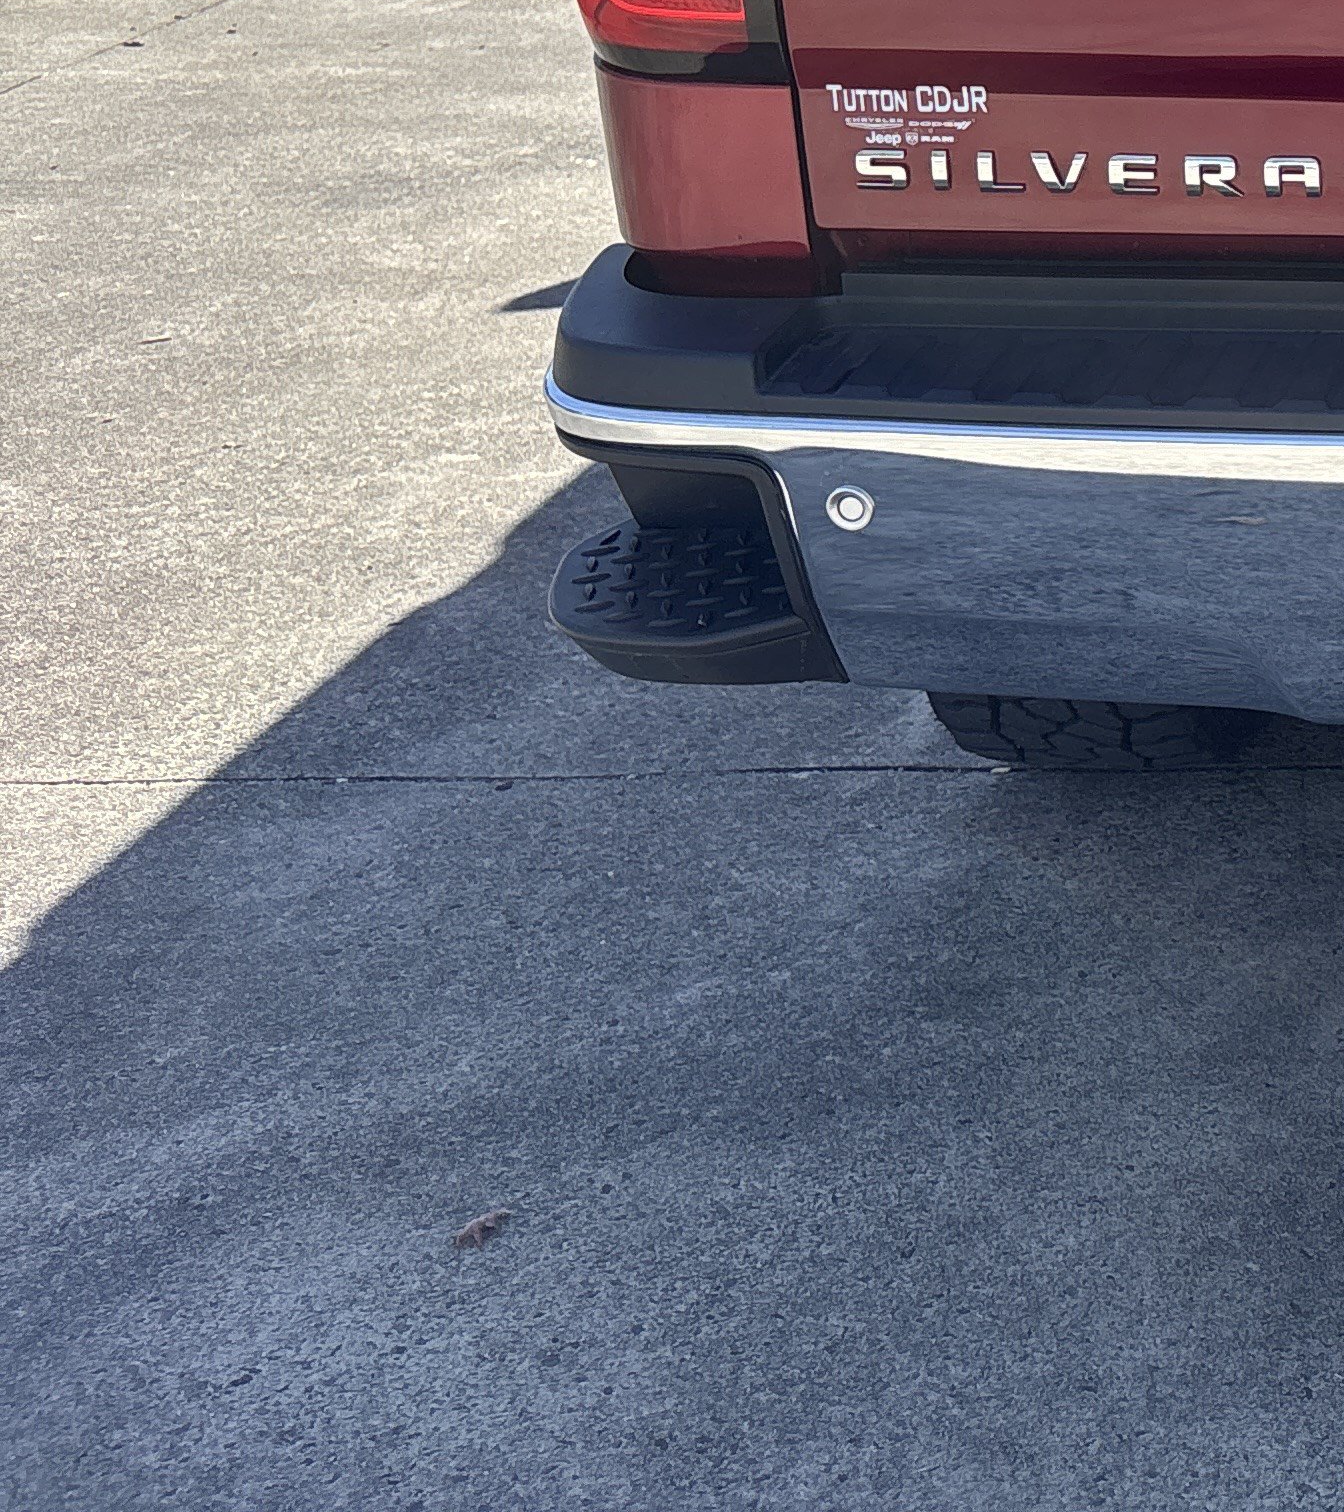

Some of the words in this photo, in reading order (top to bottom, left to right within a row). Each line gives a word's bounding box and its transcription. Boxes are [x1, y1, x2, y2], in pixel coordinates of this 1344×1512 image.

[915, 85, 988, 113] CDJR
[865, 131, 902, 146] Jeep
[920, 135, 955, 143] RAM
